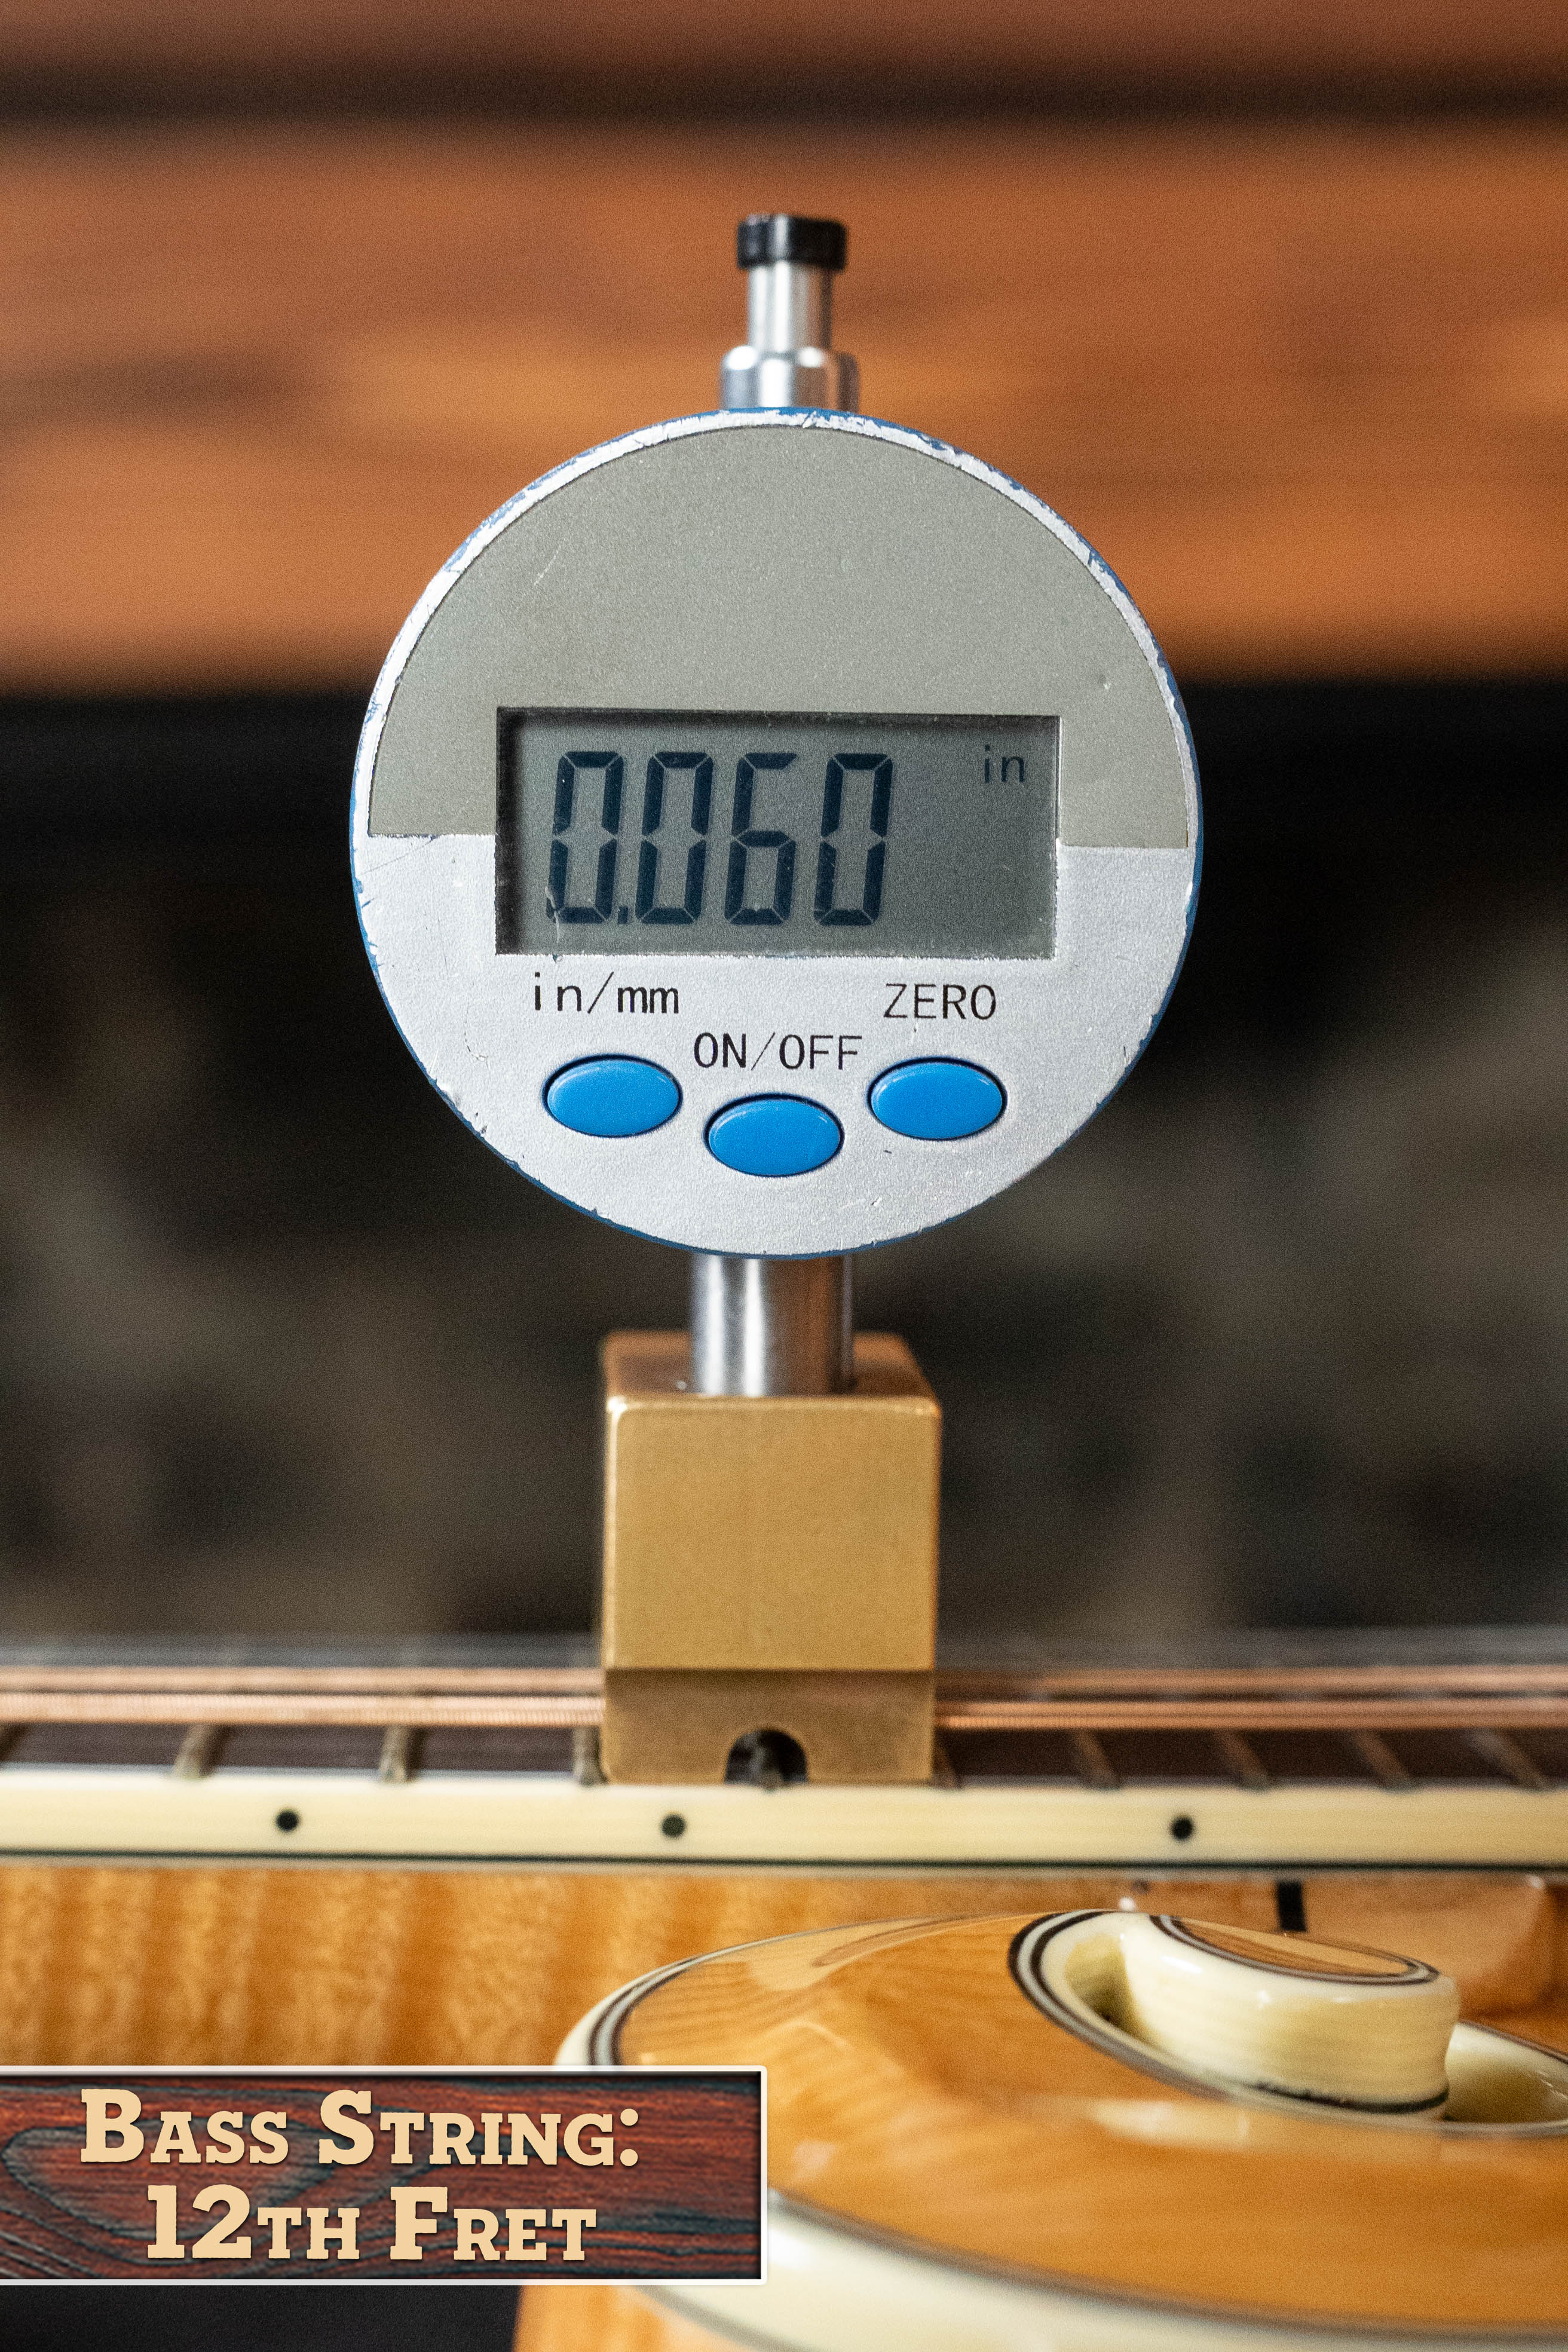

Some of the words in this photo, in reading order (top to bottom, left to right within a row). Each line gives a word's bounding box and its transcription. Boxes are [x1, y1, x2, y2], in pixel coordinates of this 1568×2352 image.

[983, 745, 1025, 784] in
[546, 751, 893, 926] 0.060
[534, 972, 679, 1015] in/mm
[883, 983, 997, 1020] ZERO
[694, 1032, 862, 1071] ON/OFF
